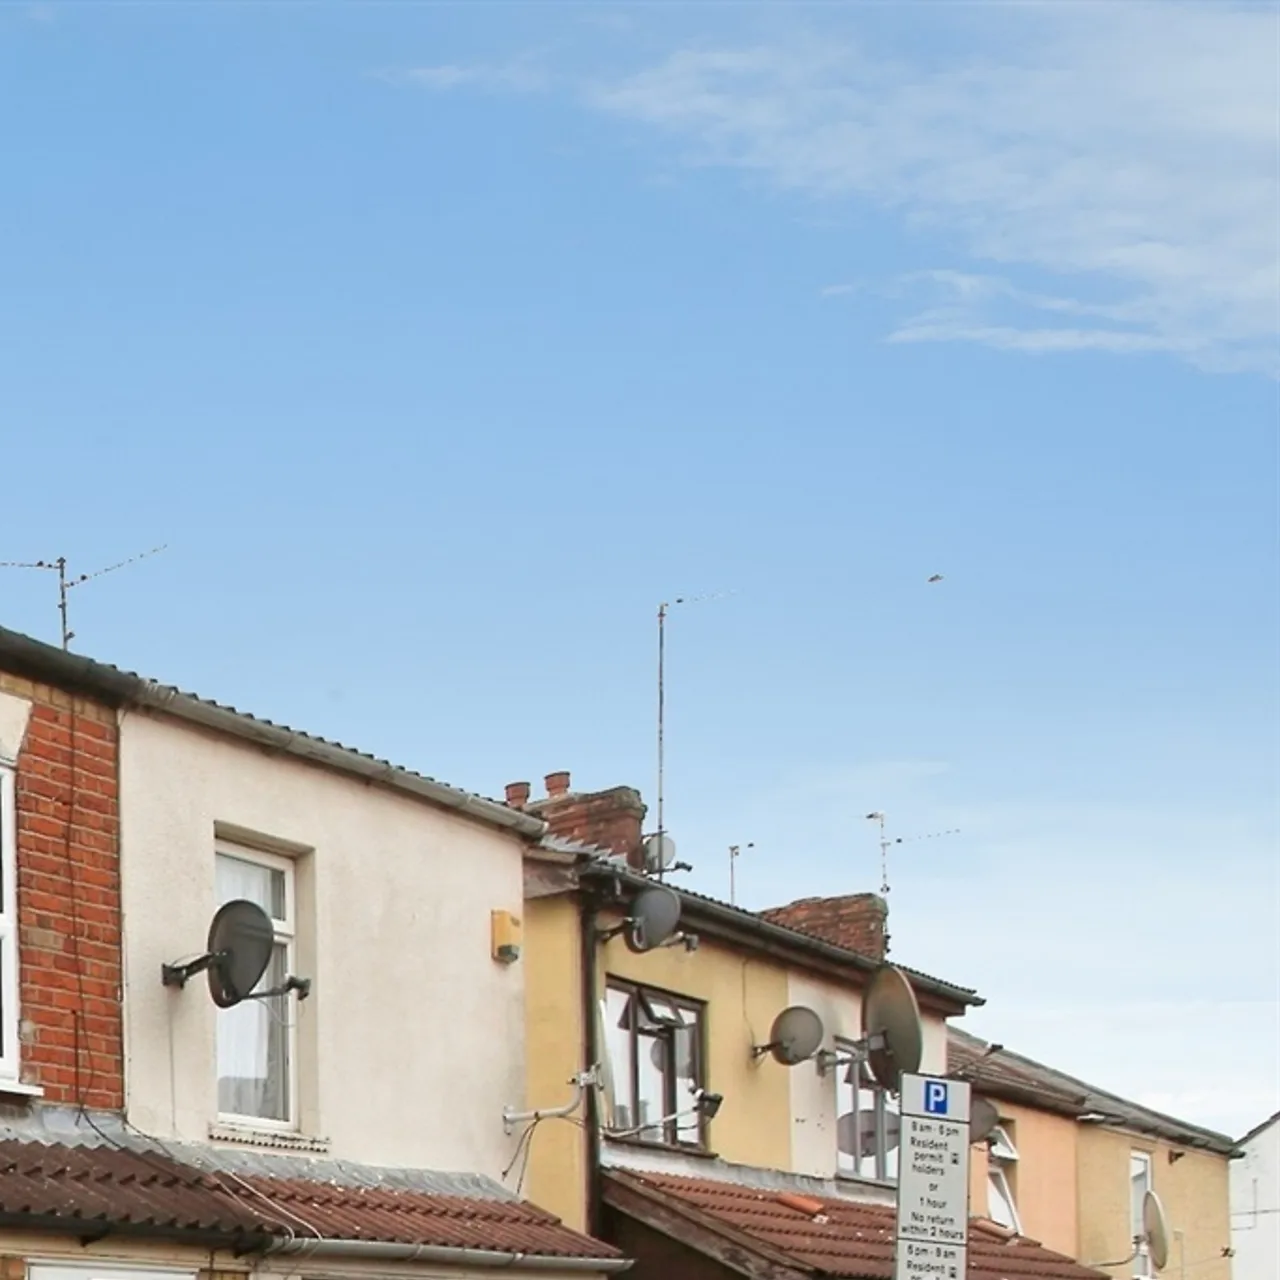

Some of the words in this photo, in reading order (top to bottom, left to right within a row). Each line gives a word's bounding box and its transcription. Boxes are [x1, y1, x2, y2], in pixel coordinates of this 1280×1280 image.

[930, 1083, 945, 1111] P
[946, 1127, 959, 1137] pm
[910, 1136, 948, 1151] Resident
[914, 1152, 943, 1163] permit
[912, 1163, 944, 1176] holders
[929, 1182, 938, 1191] or
[927, 1197, 947, 1209] hour
[911, 1211, 924, 1223] No
[927, 1214, 955, 1225] return
[901, 1225, 928, 1234] within
[930, 1226, 936, 1237] 2
[939, 1227, 964, 1240] hours
[943, 1250, 956, 1259] am
[907, 1260, 946, 1274] Resident
